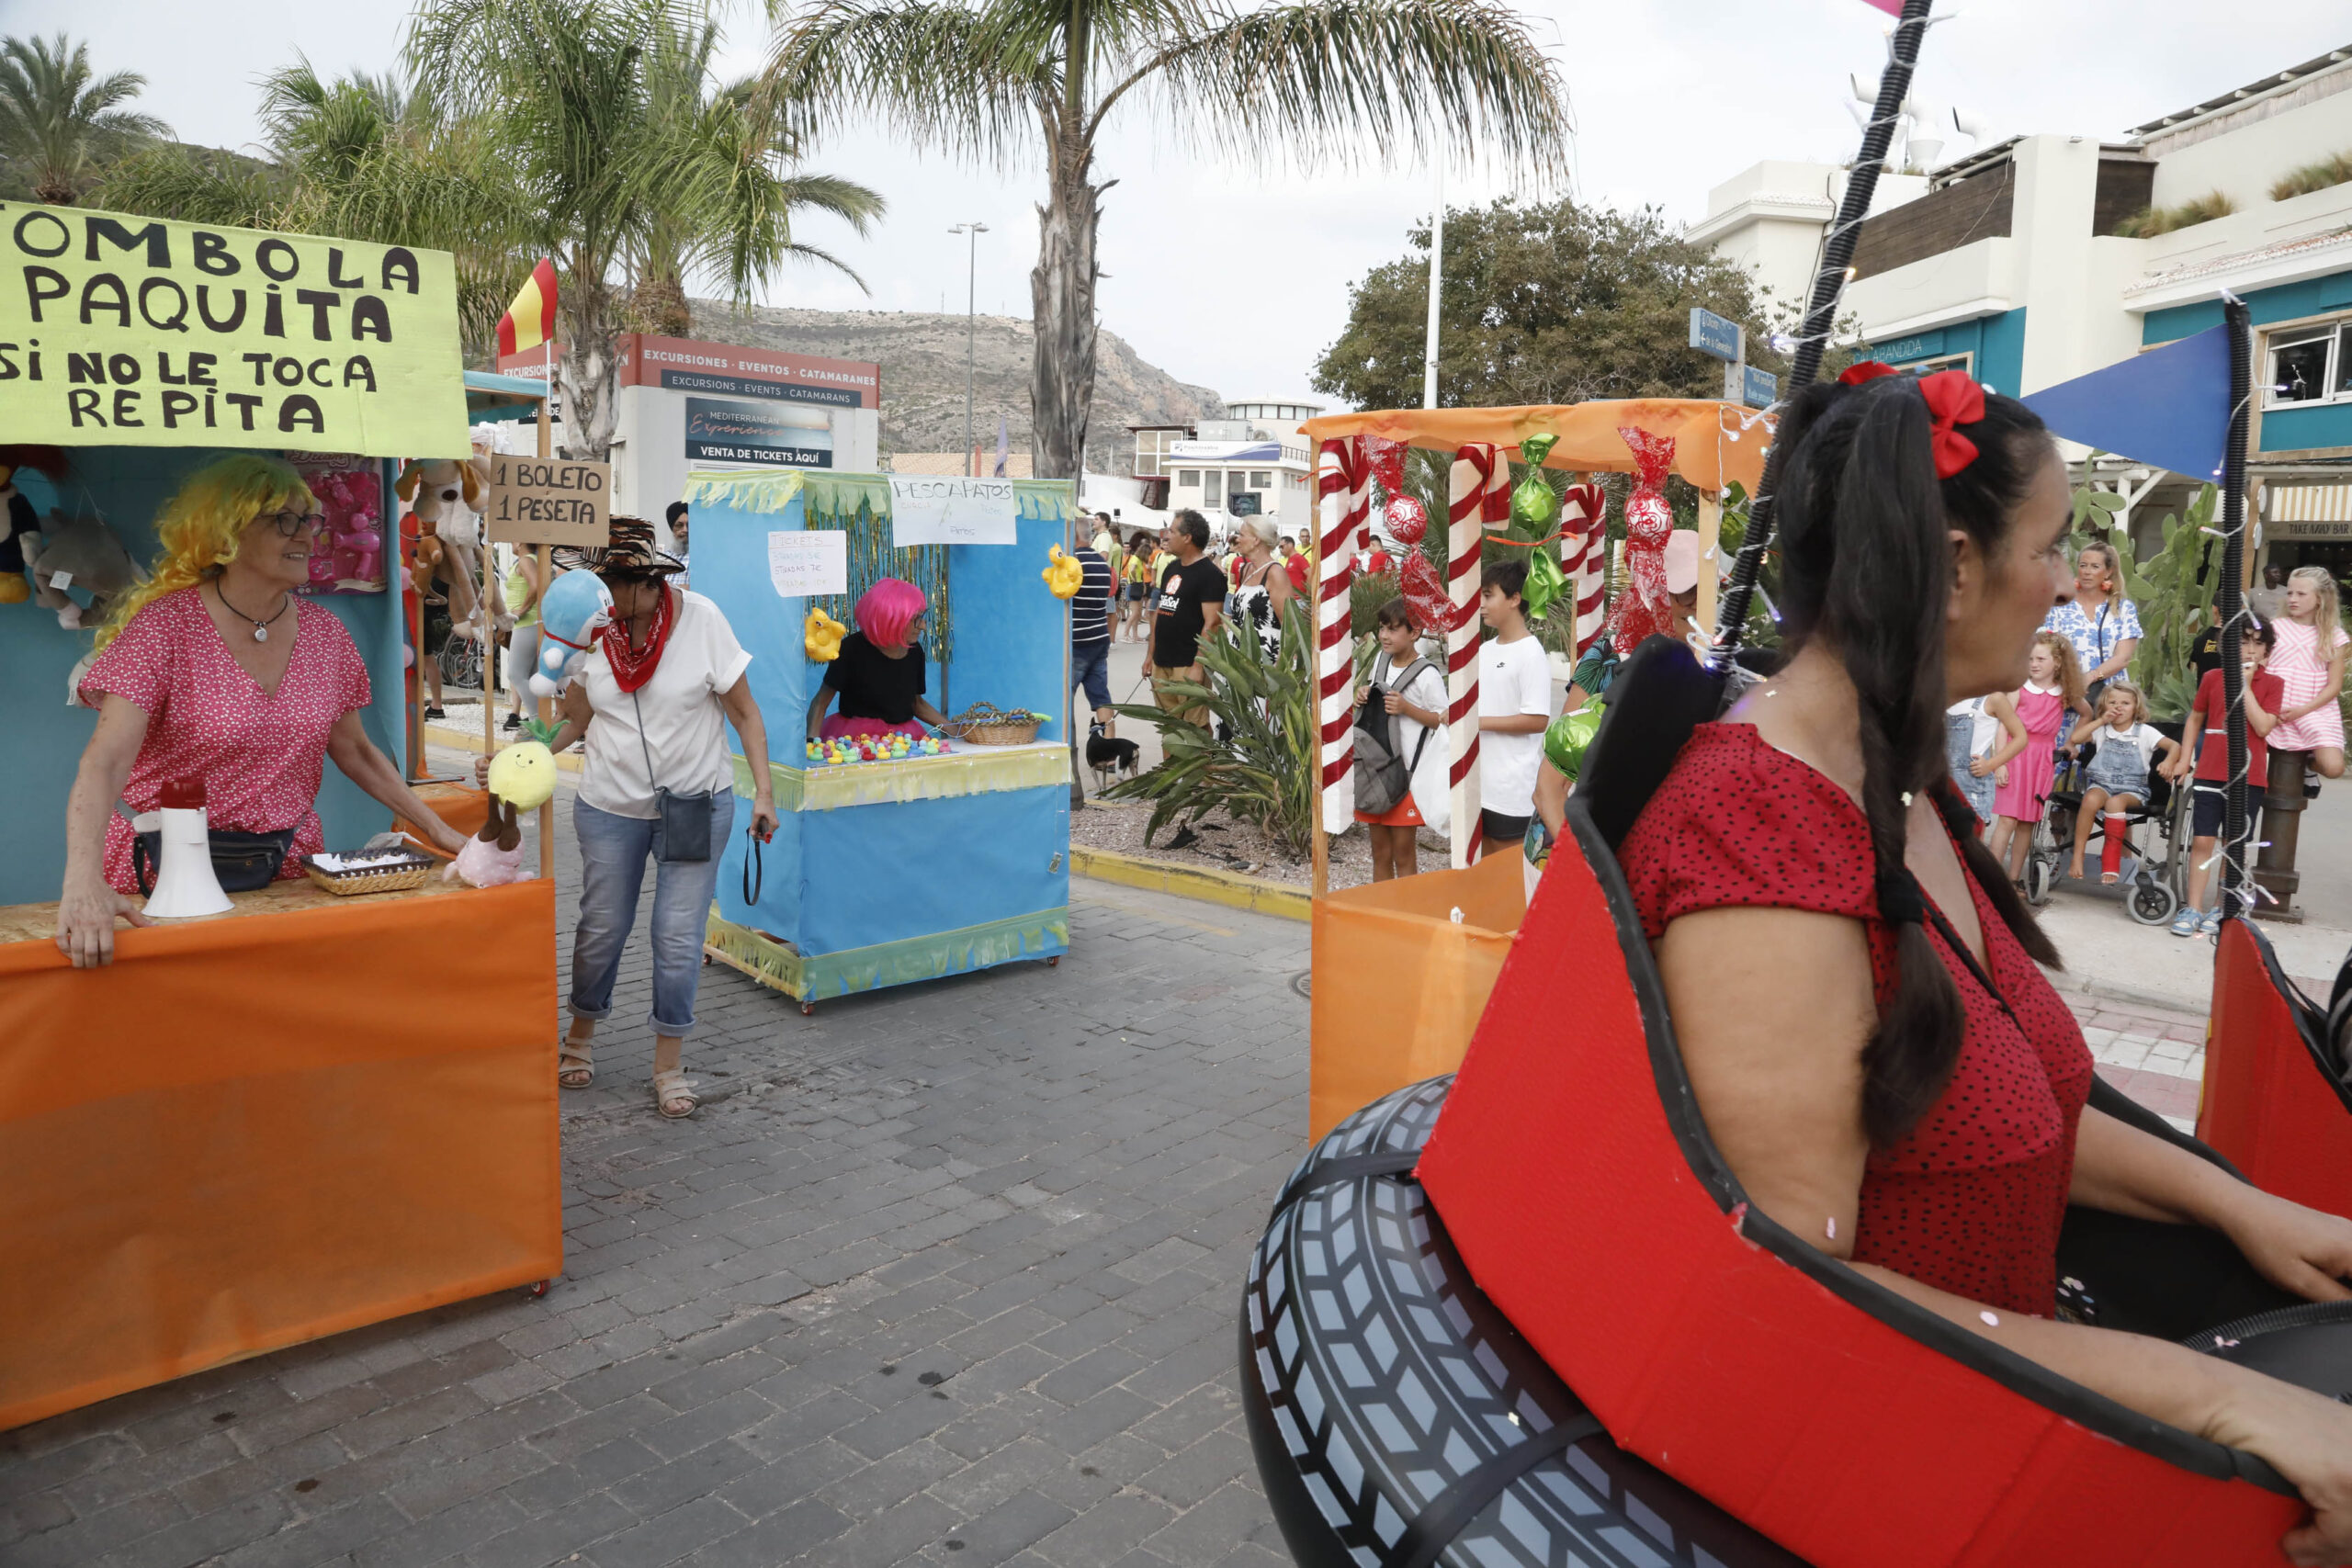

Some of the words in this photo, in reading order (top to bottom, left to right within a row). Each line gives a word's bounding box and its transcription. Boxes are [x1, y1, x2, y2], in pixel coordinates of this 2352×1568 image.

[0, 203, 420, 295] OMBOLA
[68, 353, 141, 385] NO
[158, 352, 218, 386] LE
[243, 354, 378, 393] TOCA
[644, 349, 728, 369] EXCURSIONES
[739, 360, 790, 377] EVENTOS
[799, 367, 876, 387] CATAMARANES
[672, 376, 736, 391] EXCURSIONS
[745, 383, 781, 396] EVENTS
[789, 389, 851, 403] CATAMARANS
[689, 413, 784, 436] Experience
[709, 412, 779, 425] MEDITERRANEAN
[700, 446, 734, 458] VENTA
[738, 449, 751, 458] DE
[753, 450, 793, 462] TICKETS
[795, 452, 820, 464] AQUÍ
[494, 463, 507, 486] 1
[517, 464, 603, 491] BOLETO
[496, 495, 512, 521] 1
[517, 496, 596, 525] PESETA
[770, 534, 823, 547] TICKETS
[2289, 524, 2308, 535] TAKE
[2333, 524, 2349, 535] BAR
